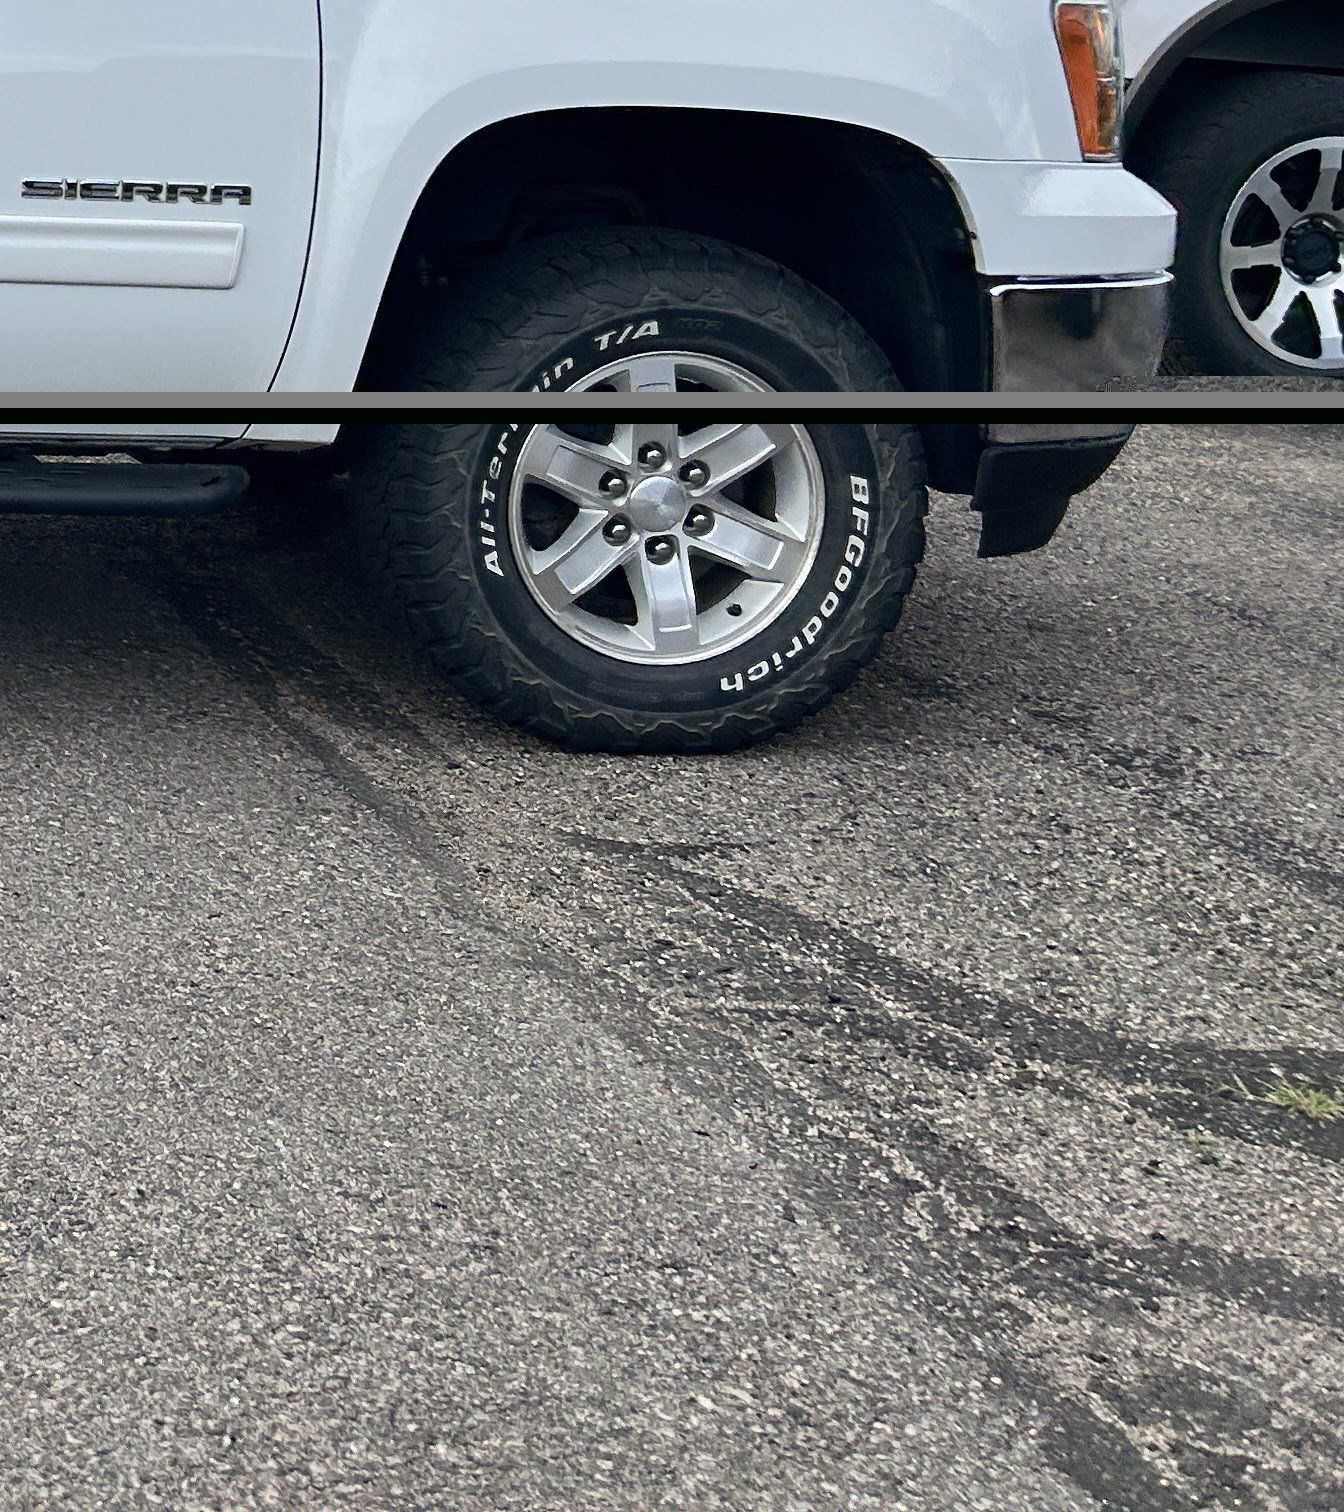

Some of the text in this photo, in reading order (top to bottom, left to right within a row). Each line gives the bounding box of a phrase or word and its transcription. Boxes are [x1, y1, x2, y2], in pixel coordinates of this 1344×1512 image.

[20, 177, 252, 206] SIERRA
[480, 319, 661, 577] All-Terin T/A
[720, 474, 870, 692] BFGoodrich
